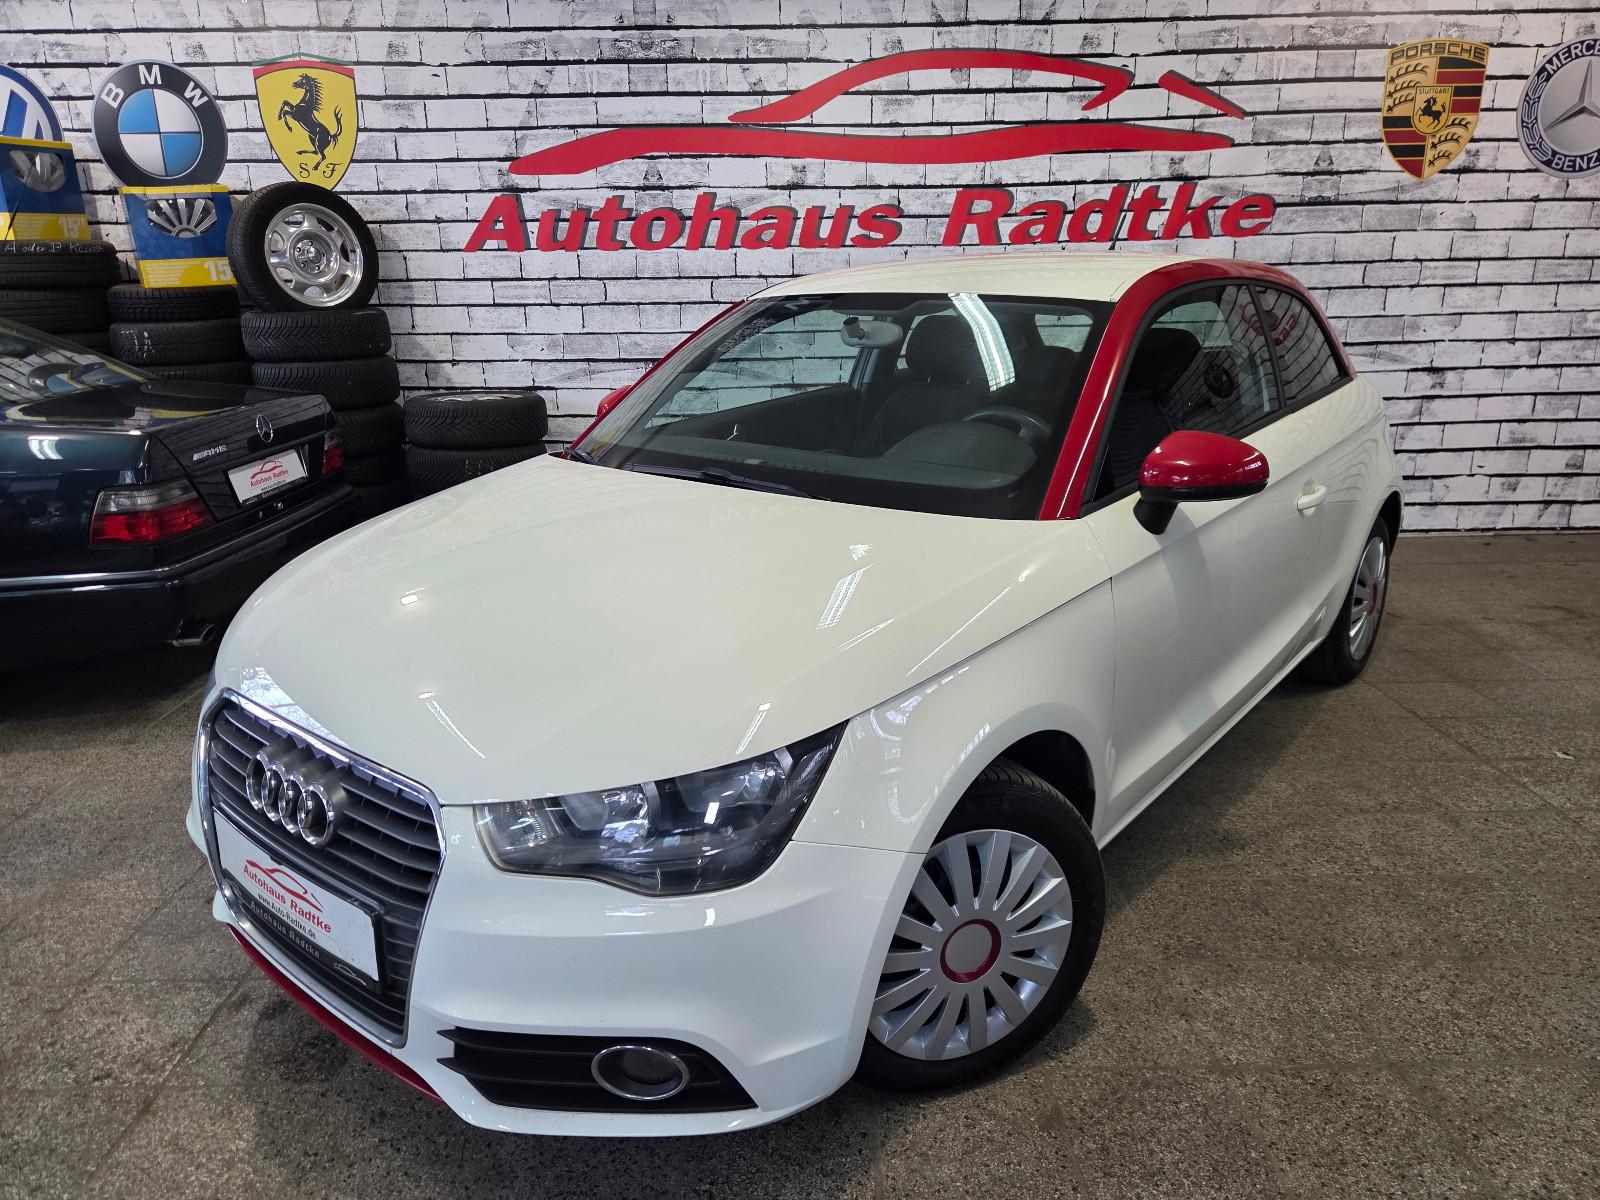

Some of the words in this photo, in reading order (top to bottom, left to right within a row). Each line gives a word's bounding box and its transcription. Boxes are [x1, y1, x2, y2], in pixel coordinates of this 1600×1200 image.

[1391, 42, 1486, 65] PORSCHE
[100, 64, 209, 109] BMW
[1551, 151, 1600, 171] BENZ
[463, 191, 903, 253] Autohaus
[941, 182, 1277, 247] Radtke
[243, 864, 286, 904] Autohaus
[290, 898, 332, 933] Radtke
[250, 900, 287, 934] Autohaus
[289, 930, 321, 958] Radtke
